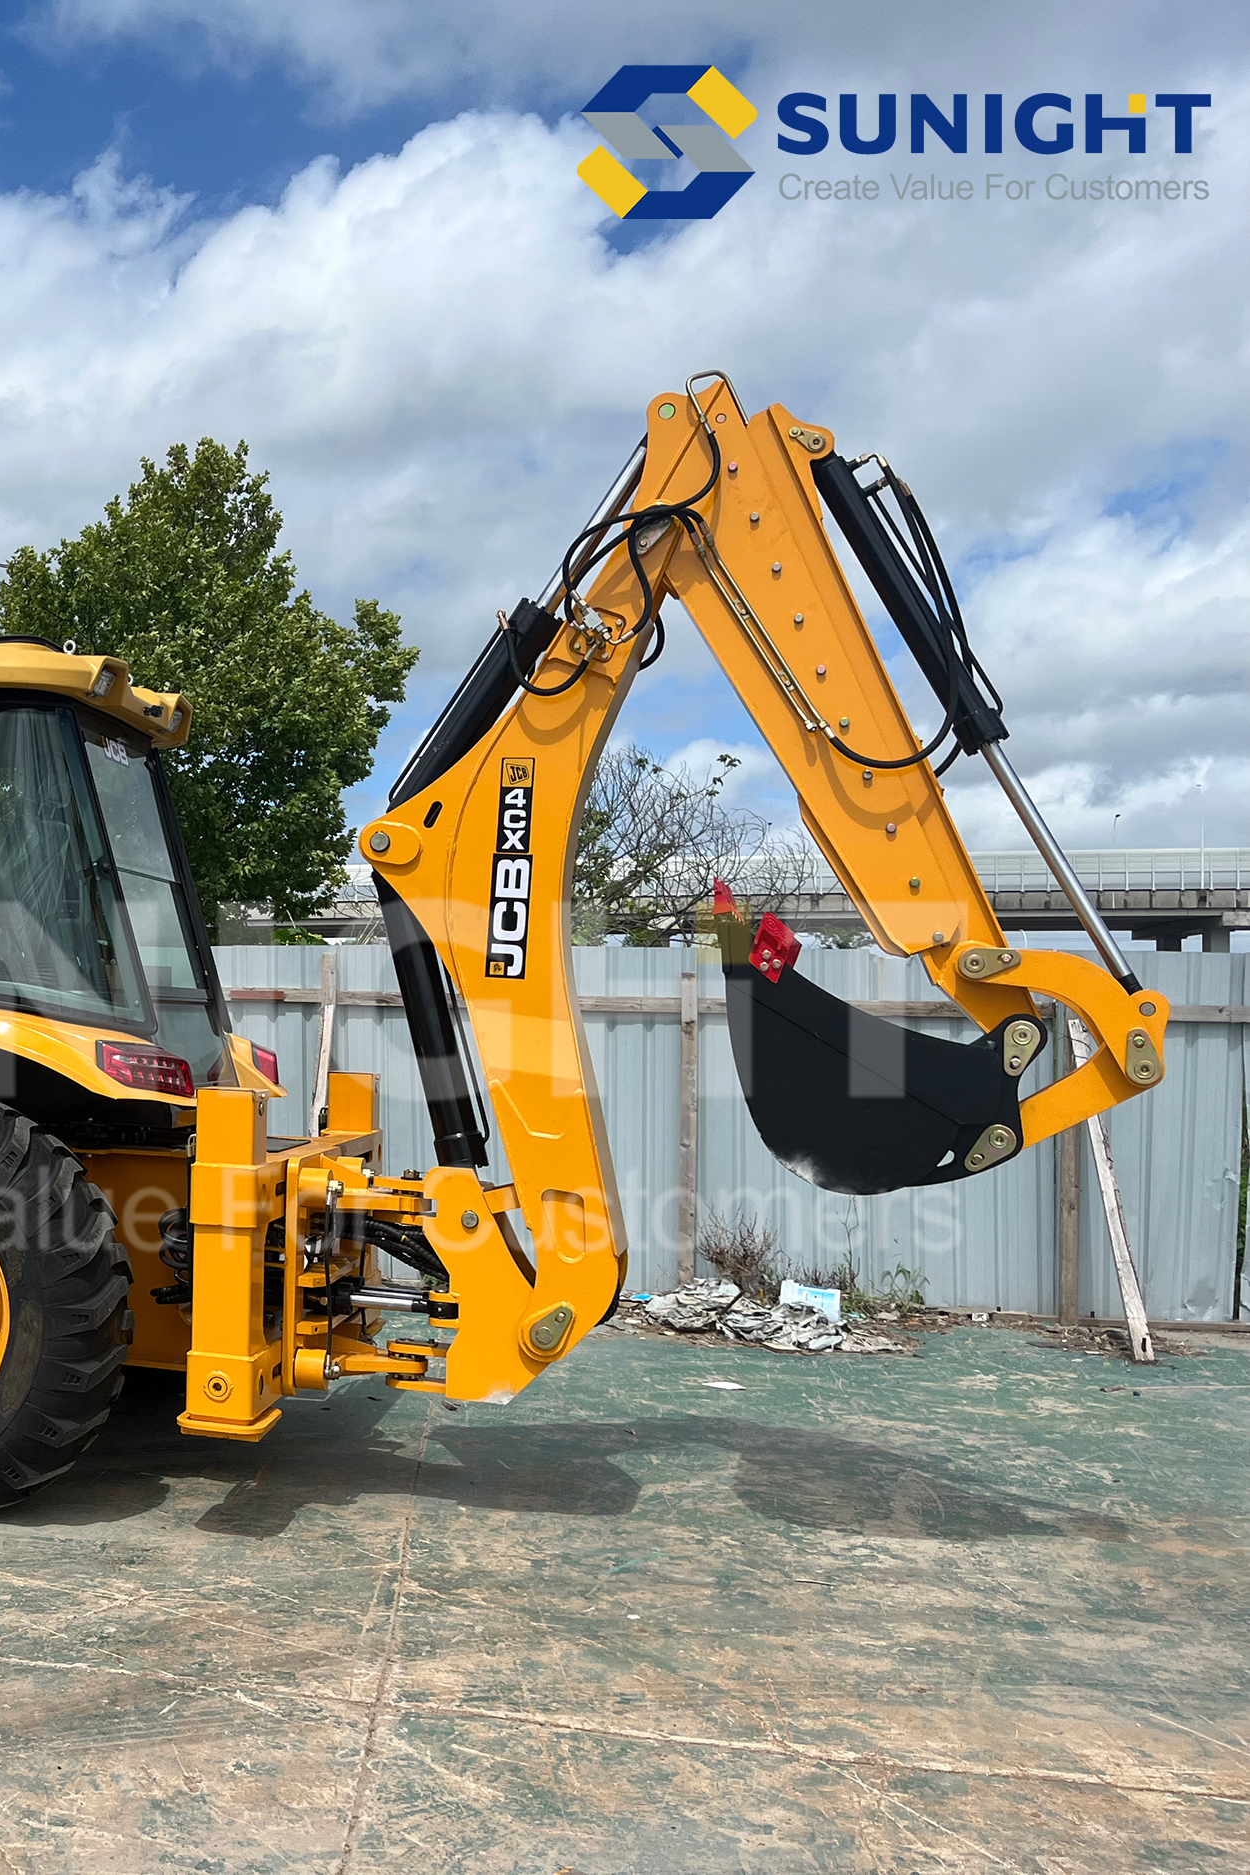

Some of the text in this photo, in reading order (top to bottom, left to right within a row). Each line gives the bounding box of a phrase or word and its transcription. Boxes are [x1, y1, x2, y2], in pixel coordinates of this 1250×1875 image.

[104, 737, 129, 766] JCB
[509, 765, 528, 782] JCB
[501, 788, 527, 850] 4CX
[490, 858, 531, 977] JCB
